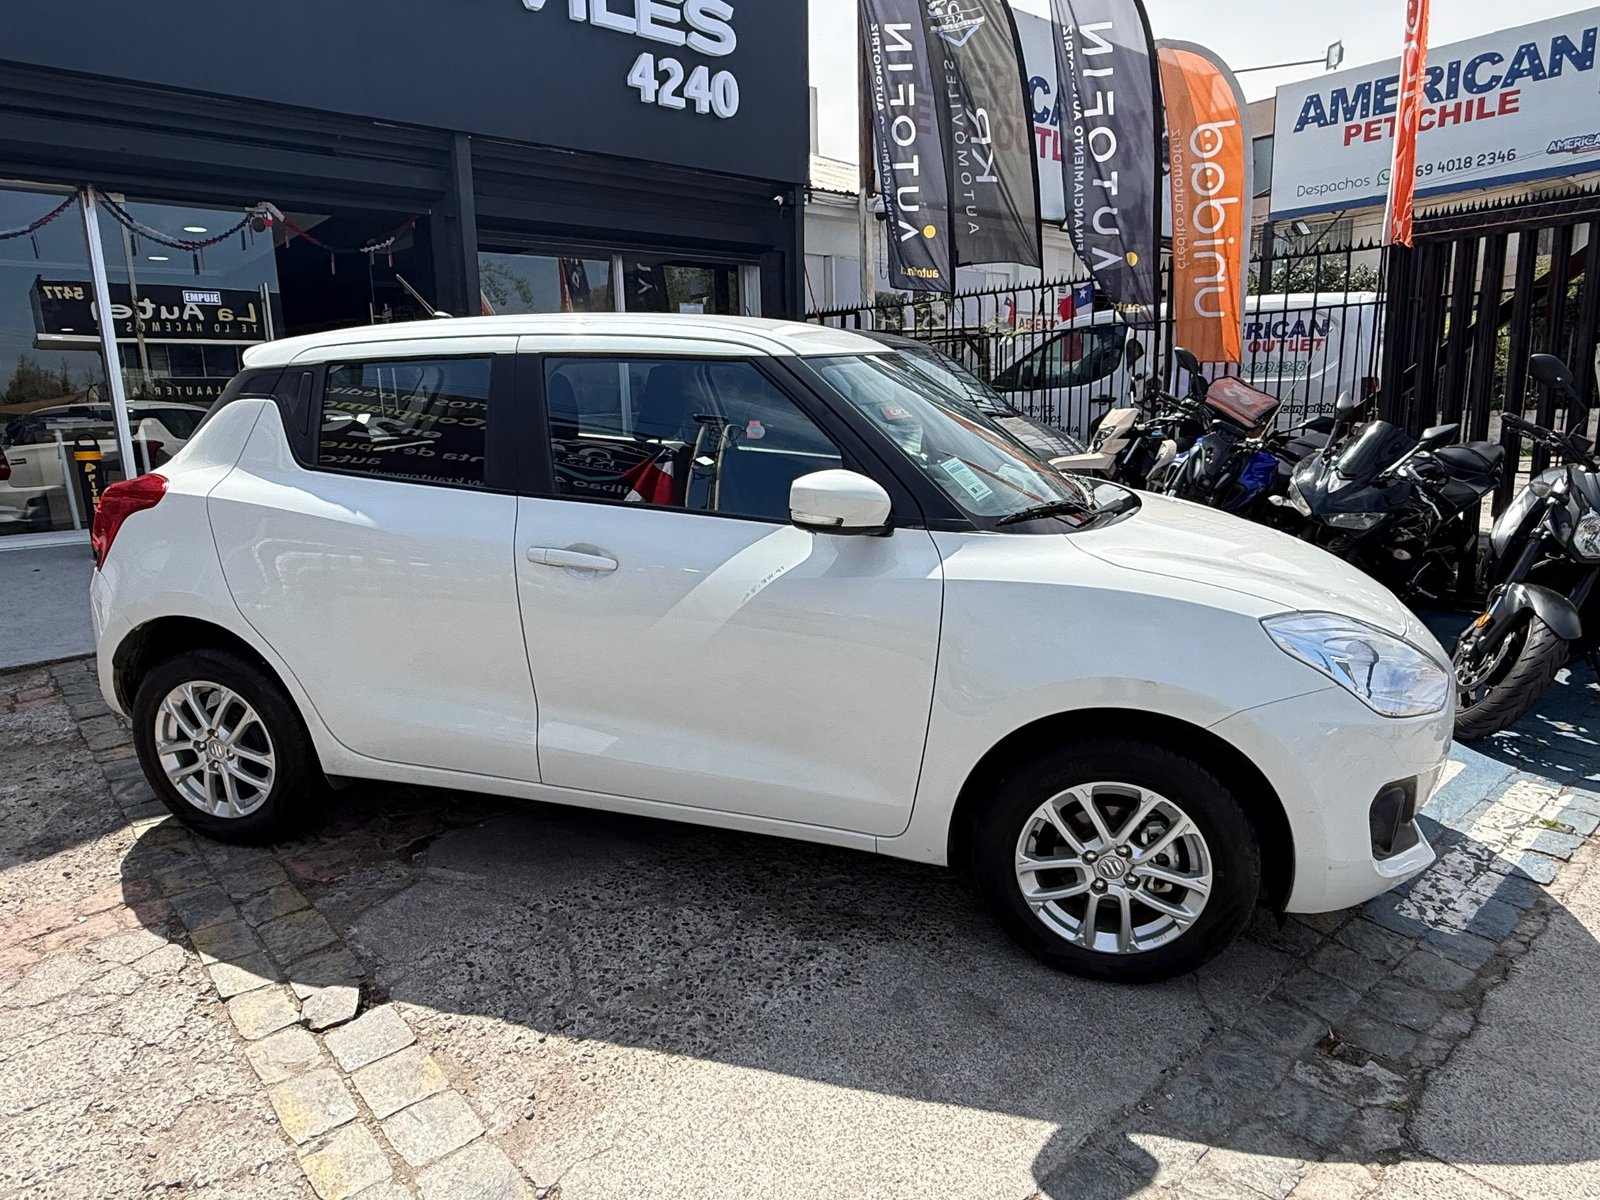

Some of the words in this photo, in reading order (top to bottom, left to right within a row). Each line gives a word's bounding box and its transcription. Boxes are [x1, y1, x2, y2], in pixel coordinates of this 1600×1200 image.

[522, 0, 737, 57] LES
[627, 52, 740, 119] 4240
[1293, 27, 1598, 133] AMERICAN
[1415, 89, 1521, 133] CHILE
[1297, 174, 1370, 198] Despachos
[1437, 155, 1473, 173] 4018
[1476, 148, 1517, 168] 2346
[185, 293, 219, 304] EMPUJE
[1018, 317, 1060, 331] ABERTO
[1243, 318, 1330, 340] RICAN
[1248, 338, 1326, 353] OUTLET
